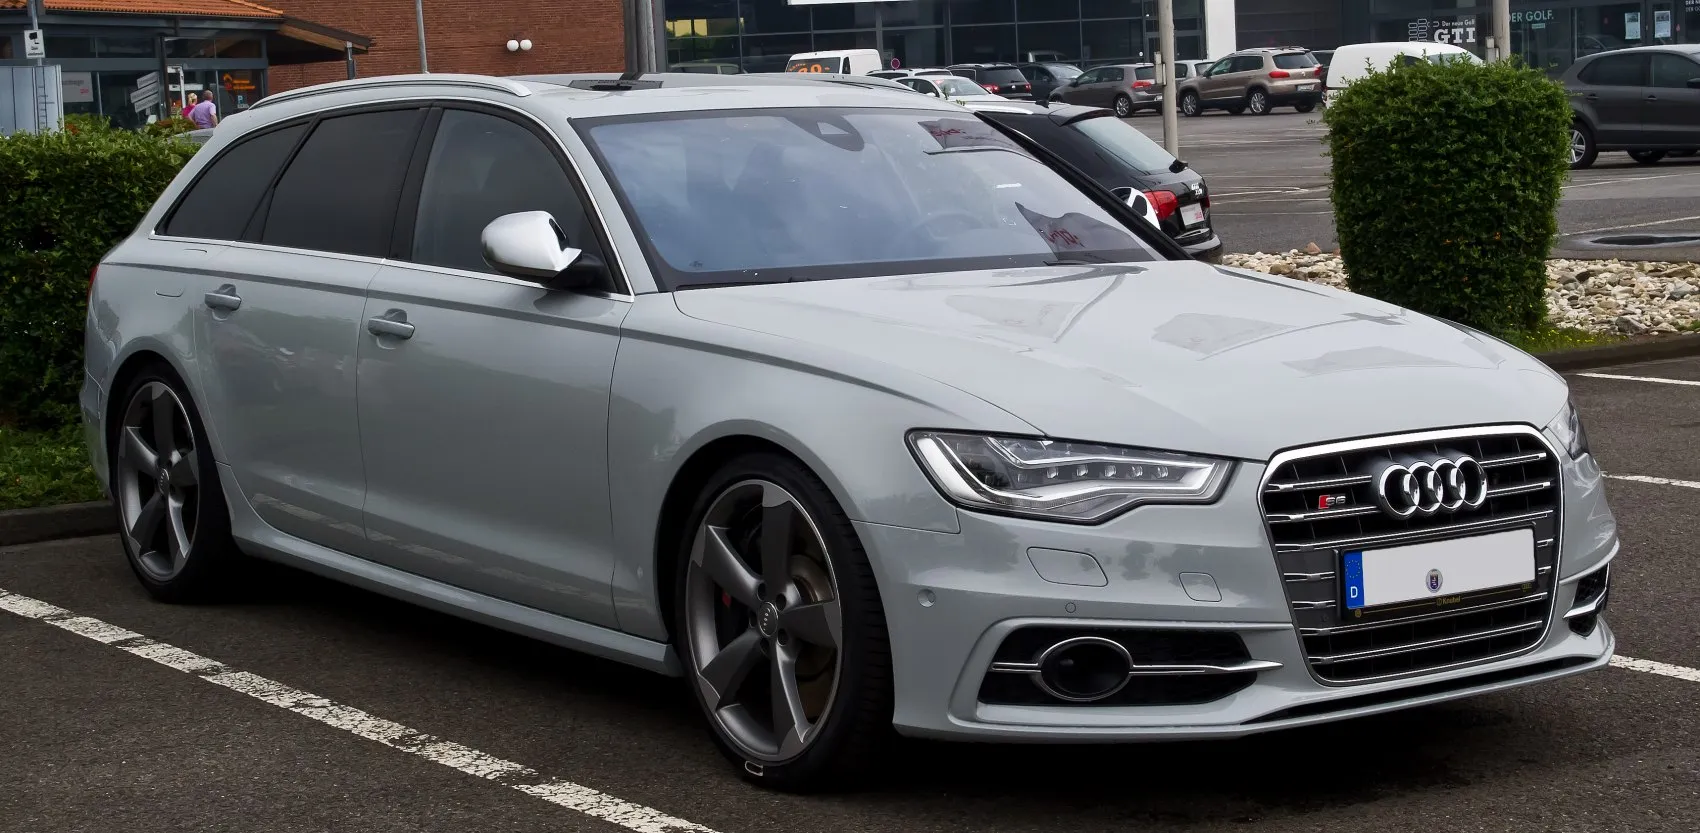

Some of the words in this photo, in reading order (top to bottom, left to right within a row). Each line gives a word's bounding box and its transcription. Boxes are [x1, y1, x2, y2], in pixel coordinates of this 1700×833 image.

[1526, 10, 1554, 21] GOLF.
[1434, 27, 1475, 44] GTI
[1350, 586, 1358, 598] D
